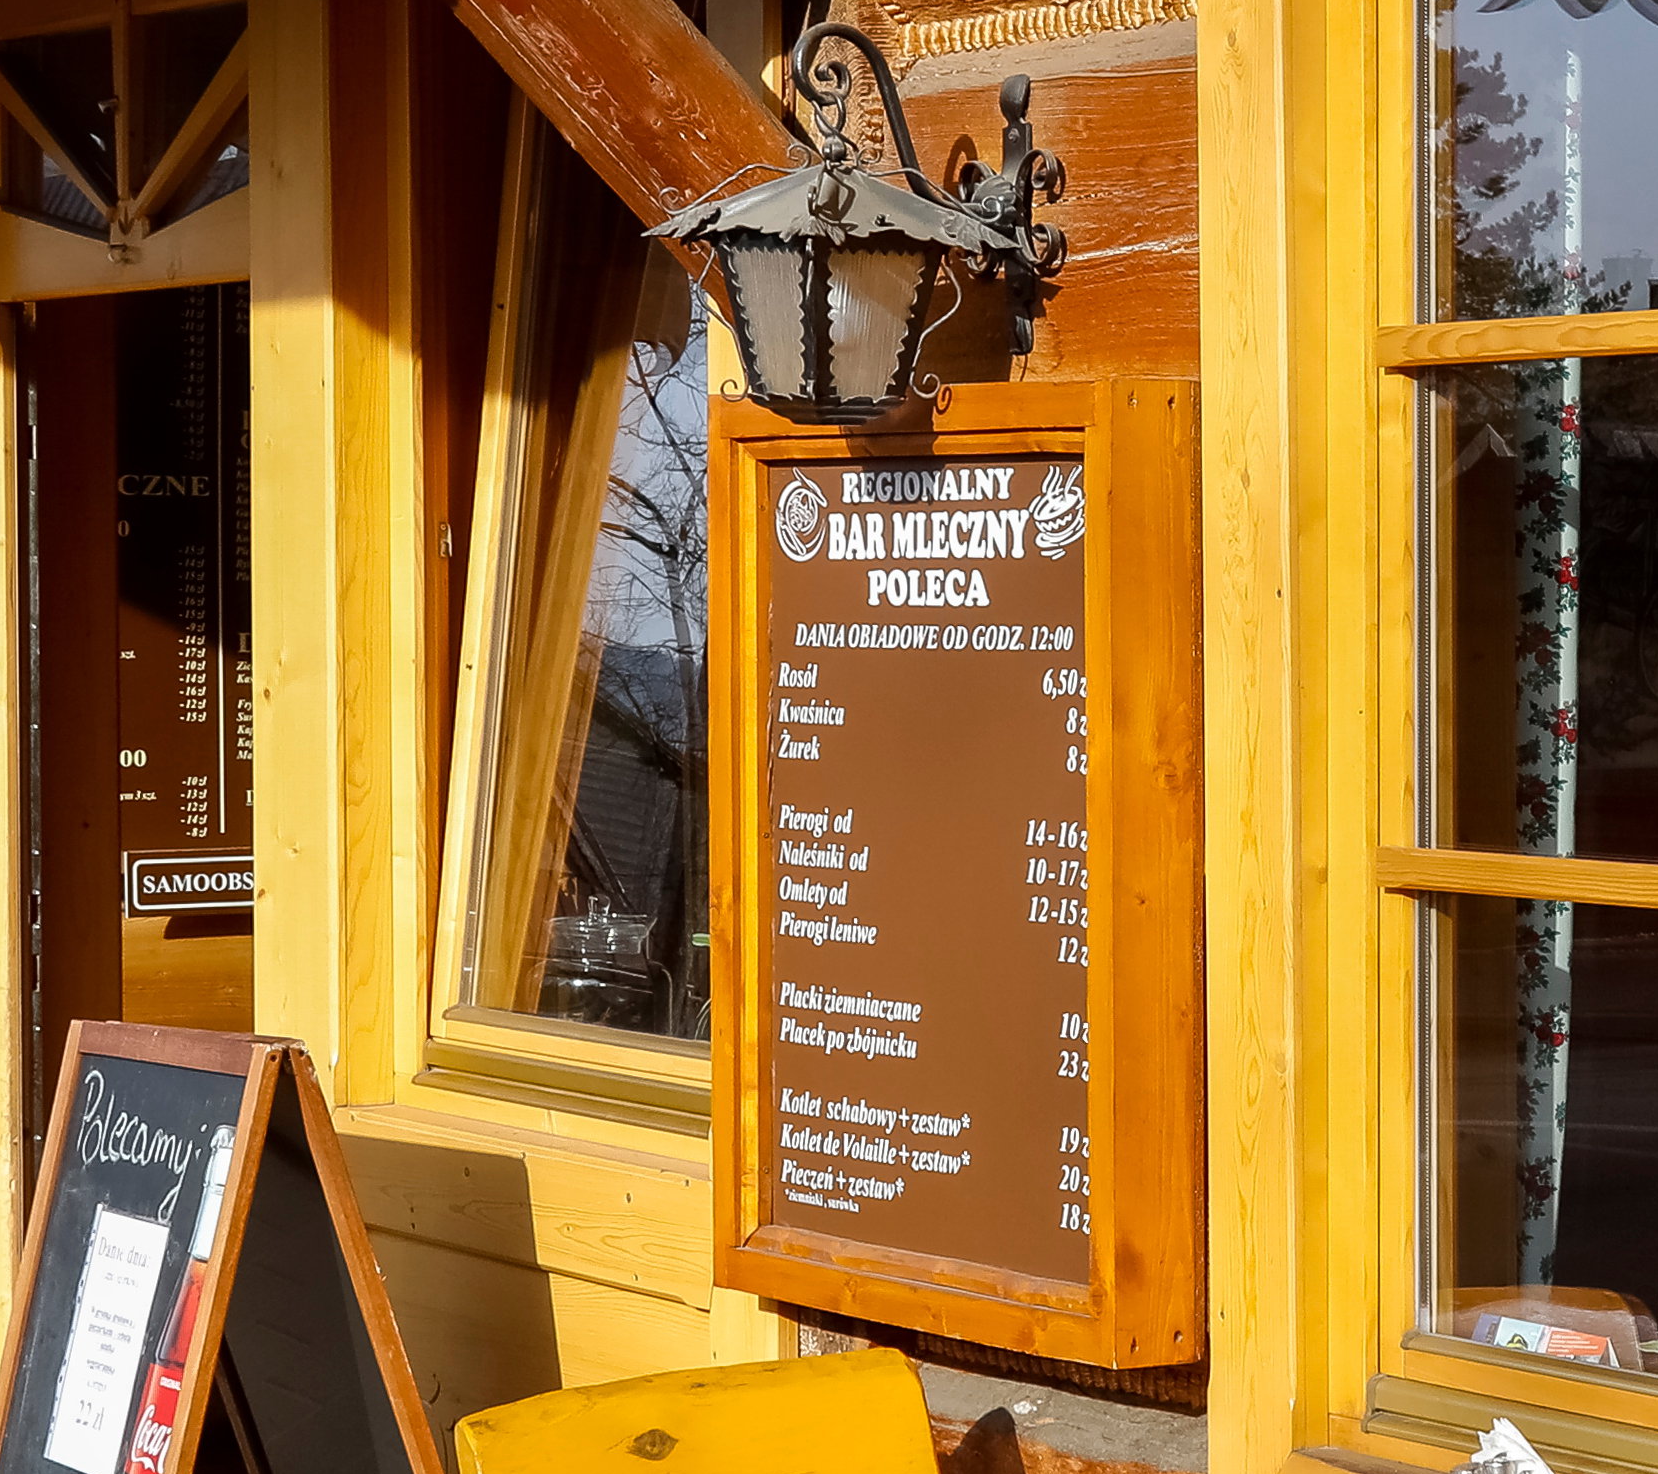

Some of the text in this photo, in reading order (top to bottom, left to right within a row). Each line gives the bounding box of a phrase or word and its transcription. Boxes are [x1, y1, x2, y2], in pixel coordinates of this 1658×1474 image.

[117, 474, 211, 497] CZNE
[842, 467, 1015, 504] REGIONALNY
[828, 509, 1030, 560] BAR MLECZNY
[867, 568, 990, 607] POLECA
[795, 623, 1074, 651] DANIA OBIADOWE OD GODZ. 12:00
[778, 662, 1087, 700] Rosół 6,50 z
[778, 698, 1088, 737] Kwaśnica 8 z
[778, 729, 1088, 775] Żurek 8 z
[778, 804, 829, 838] Pierogi
[833, 808, 853, 834] od
[1079, 830, 1088, 852] z
[143, 872, 254, 894] SAMOOBS
[778, 840, 845, 869] Naleśniki
[849, 846, 869, 872] od
[1080, 869, 1089, 890] z
[779, 875, 828, 910] Omlety
[828, 881, 848, 906] od
[1080, 907, 1089, 929] z
[779, 911, 1089, 967] Pierogi leniwe 12 z
[779, 981, 1089, 1044] Placki ziemniaczane 10 z
[779, 1017, 1089, 1082] Placek po zbójnicku 23 z
[779, 1087, 822, 1117] Kotlet
[826, 1096, 897, 1137] schabowy
[1059, 1126, 1080, 1154] 19
[1081, 1137, 1090, 1158] z
[780, 1123, 823, 1153] Kotlet
[822, 1130, 841, 1156] de
[843, 1134, 897, 1166] Volaille
[1058, 1164, 1080, 1192] 20
[1081, 1175, 1090, 1196] z
[780, 1158, 834, 1190] Pieczeń
[1060, 1203, 1081, 1231] 18
[1082, 1213, 1091, 1235] z
